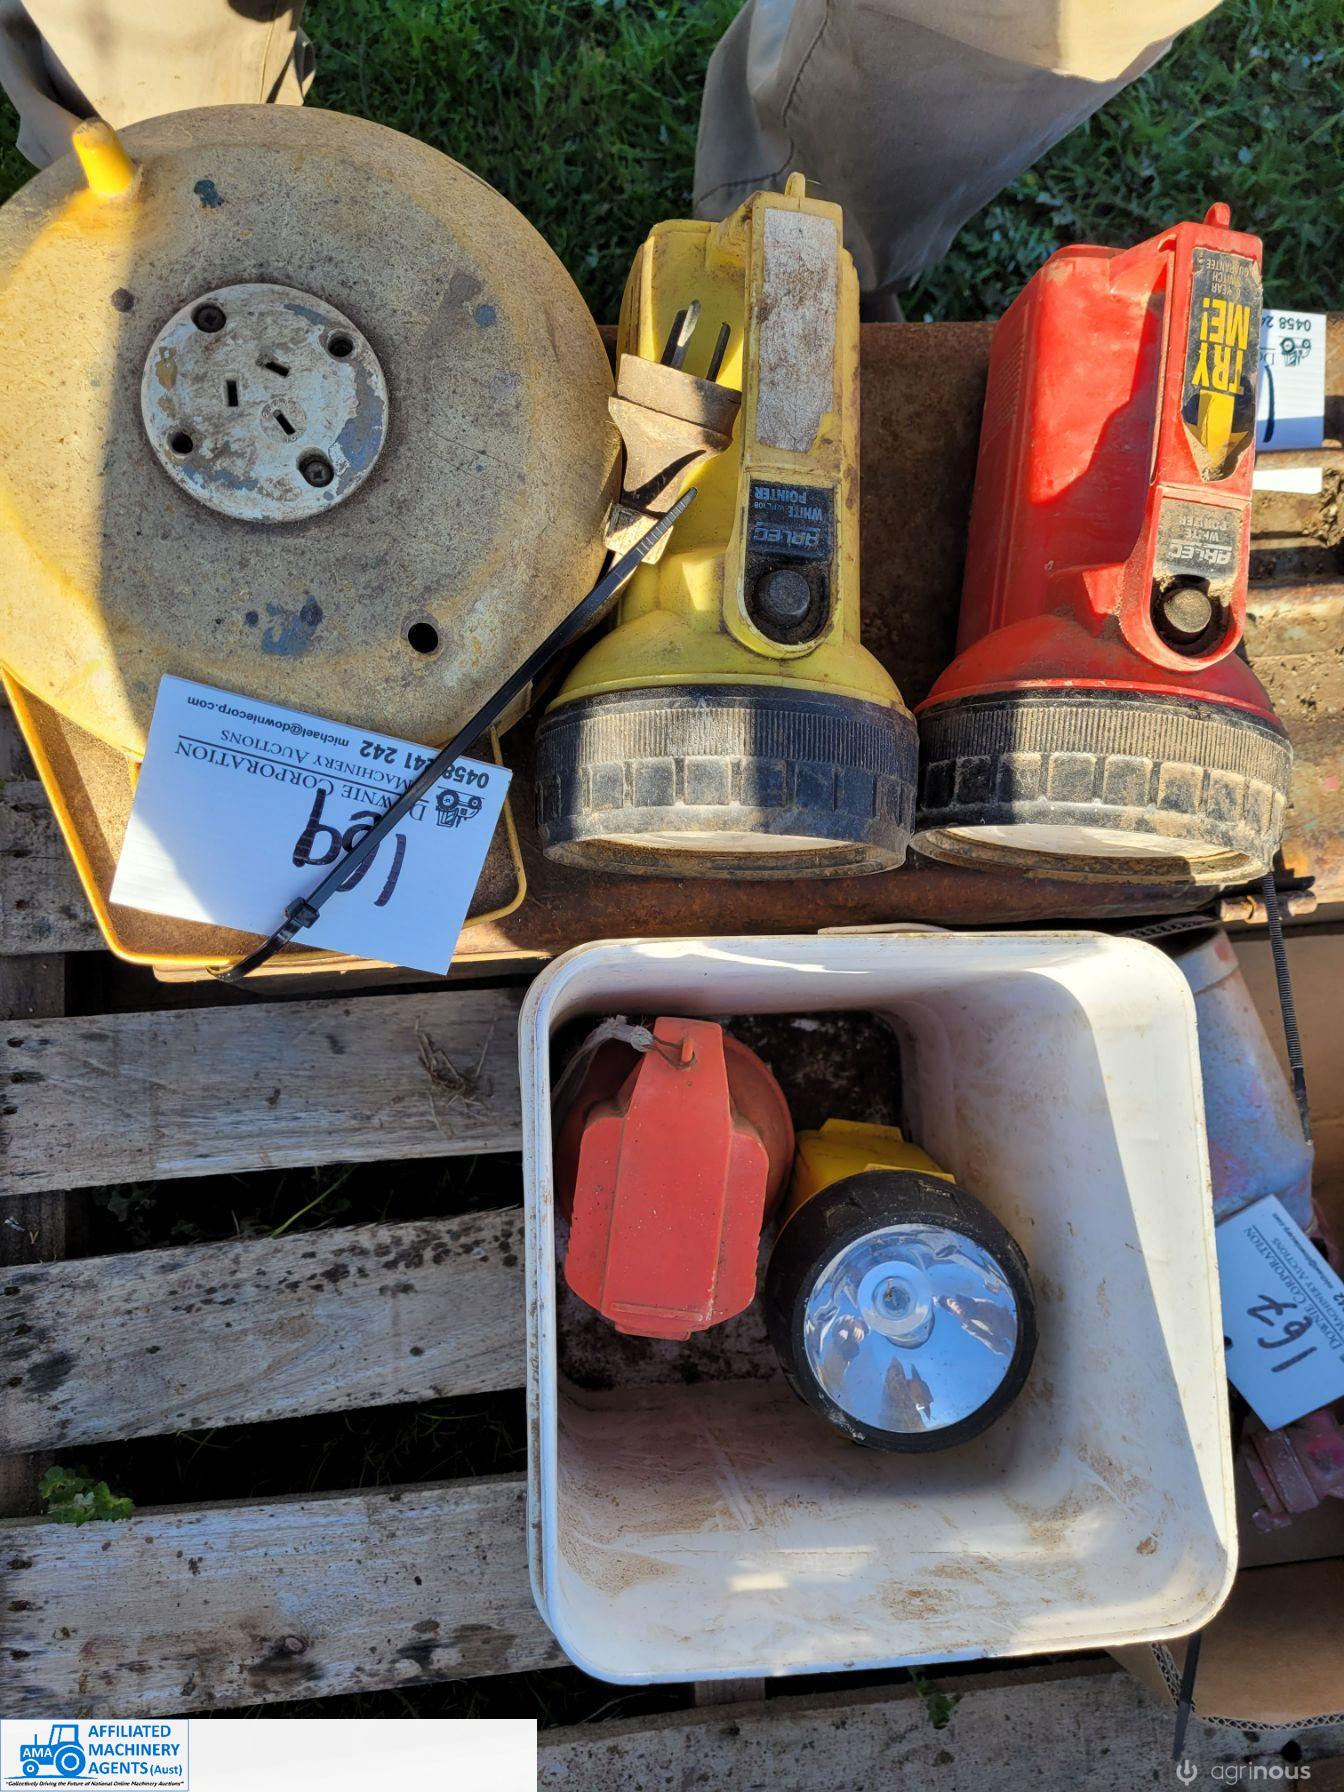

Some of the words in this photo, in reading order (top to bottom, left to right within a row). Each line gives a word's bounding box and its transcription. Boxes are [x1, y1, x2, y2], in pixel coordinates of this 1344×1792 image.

[1211, 281, 1233, 296] YEAR
[1200, 297, 1250, 350] ME!
[1279, 316, 1312, 332] 0458
[1191, 342, 1244, 394] TRY
[755, 487, 807, 504] POINTER
[788, 505, 823, 522] WHITE
[754, 528, 820, 547] ARLEC
[1166, 543, 1232, 566] ARLEC
[1184, 528, 1219, 543] WHITE
[187, 696, 350, 748] michael@downiecorp.com
[220, 730, 308, 765] AUCTIONS
[359, 740, 398, 765] 242
[174, 741, 335, 797] CORPORATION
[311, 754, 412, 792] MACHINERY
[341, 784, 427, 823] DWNIE
[1242, 1226, 1307, 1305] CORPORATION
[1270, 1236, 1309, 1283] AUCTIONS
[1246, 1294, 1317, 1373] 167
[1303, 1301, 1343, 1351] DOWNIE
